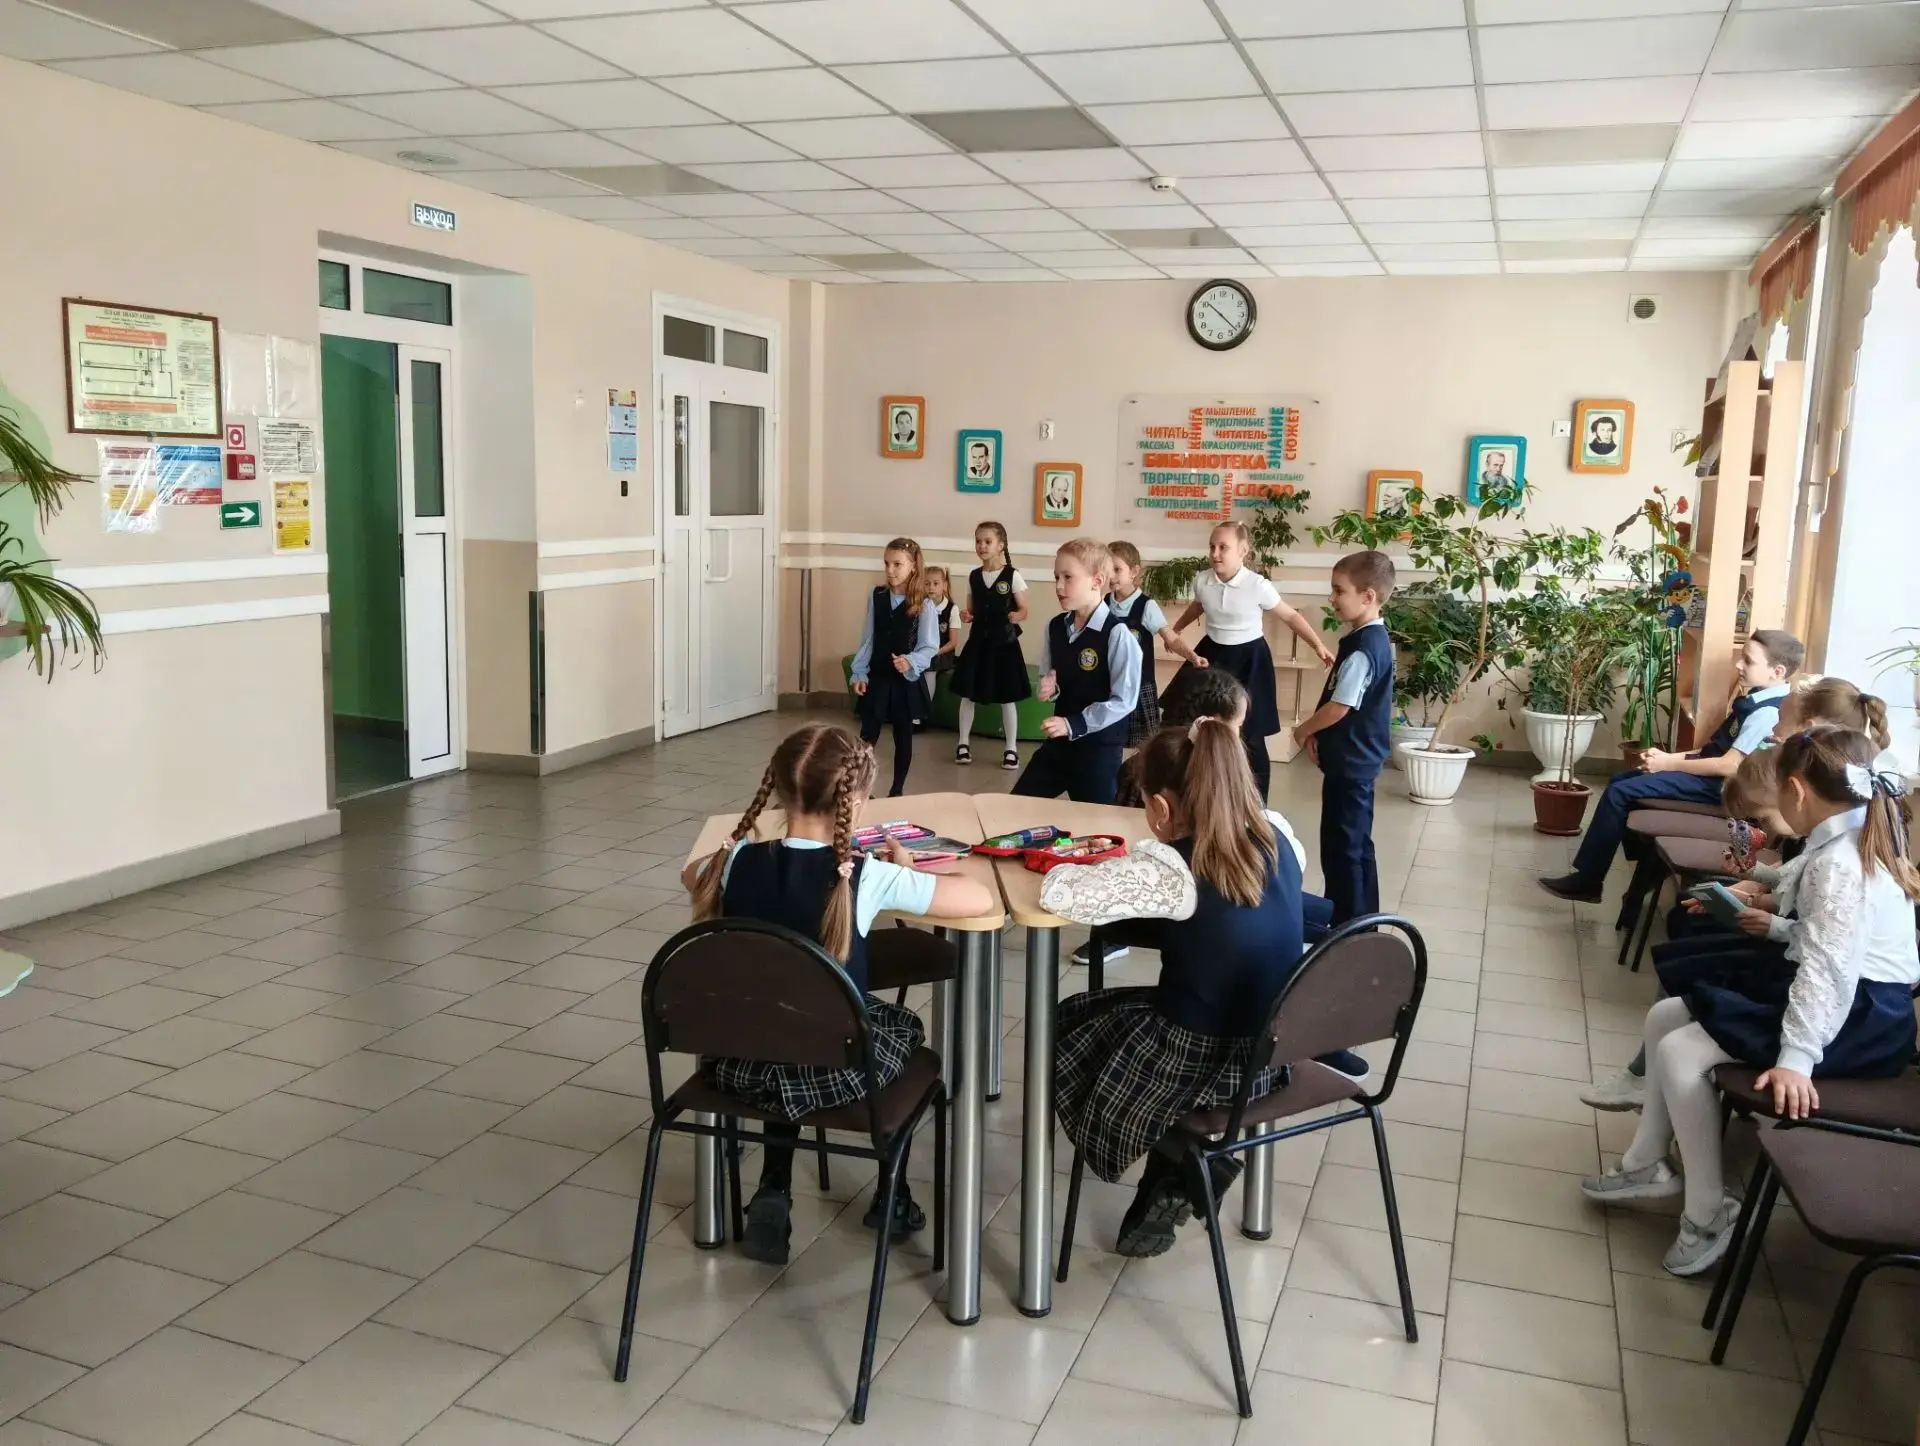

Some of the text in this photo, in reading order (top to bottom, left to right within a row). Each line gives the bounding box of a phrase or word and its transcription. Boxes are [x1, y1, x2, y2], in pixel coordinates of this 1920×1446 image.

[416, 206, 454, 228] ВЫХОД
[1205, 407, 1257, 416] МЫШЛЕНИЕ
[1188, 407, 1203, 450] КНИГА
[1204, 417, 1265, 428] ТРУДОЛЮБИЕ
[1144, 426, 1189, 439] ЧИТАТЬ
[1214, 429, 1268, 440] ЧИТАТЕЛЬ
[1268, 406, 1285, 470] ЗНАНИЕ
[1285, 407, 1300, 461] СЮЖЕТ
[1138, 440, 1175, 450] РАССКАЗ
[1142, 452, 1267, 470] БИБЛИОТЕКА
[1140, 472, 1221, 486] ТВОРЧЕСТВО
[1148, 485, 1209, 498] ИНТЕРЕС
[1135, 498, 1220, 510] СТИХОТВОРЕНИЕ
